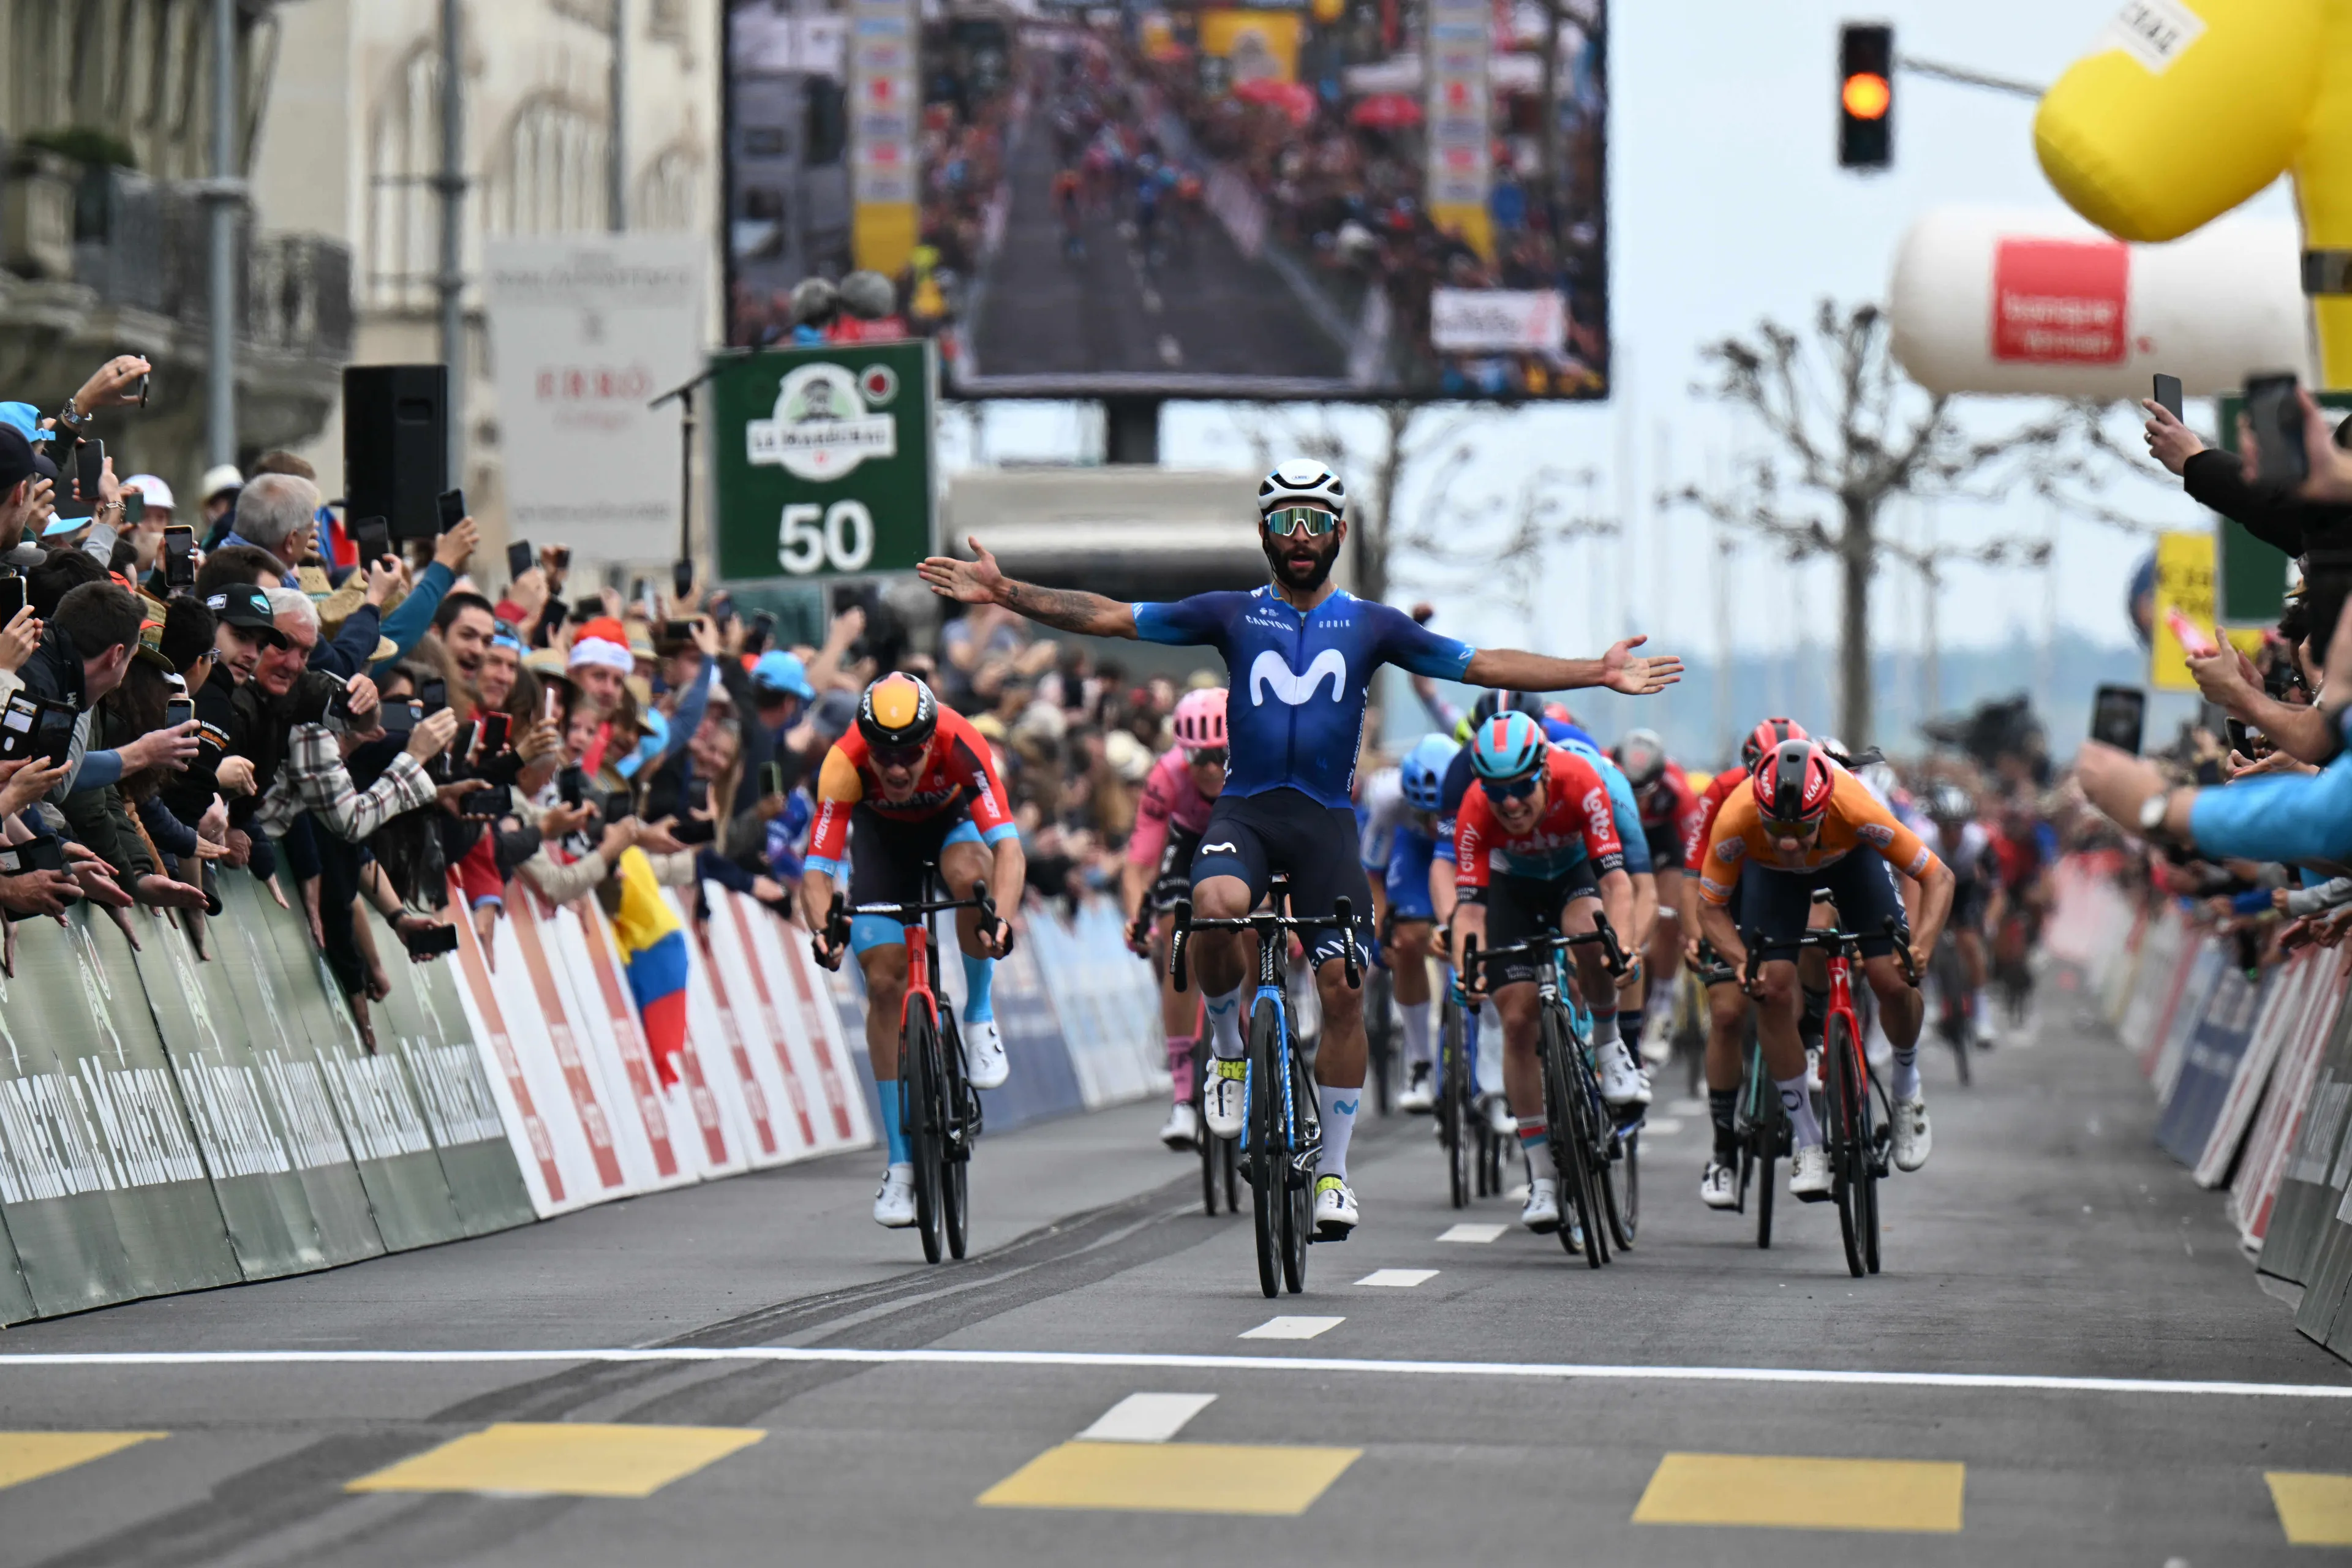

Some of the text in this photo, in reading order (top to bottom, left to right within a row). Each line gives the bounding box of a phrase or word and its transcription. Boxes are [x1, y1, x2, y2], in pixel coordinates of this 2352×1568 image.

[778, 499, 875, 575] 50
[1245, 615, 1294, 631] CANYON
[1319, 620, 1351, 628] GOBIK
[1582, 786, 1610, 841] lotto
